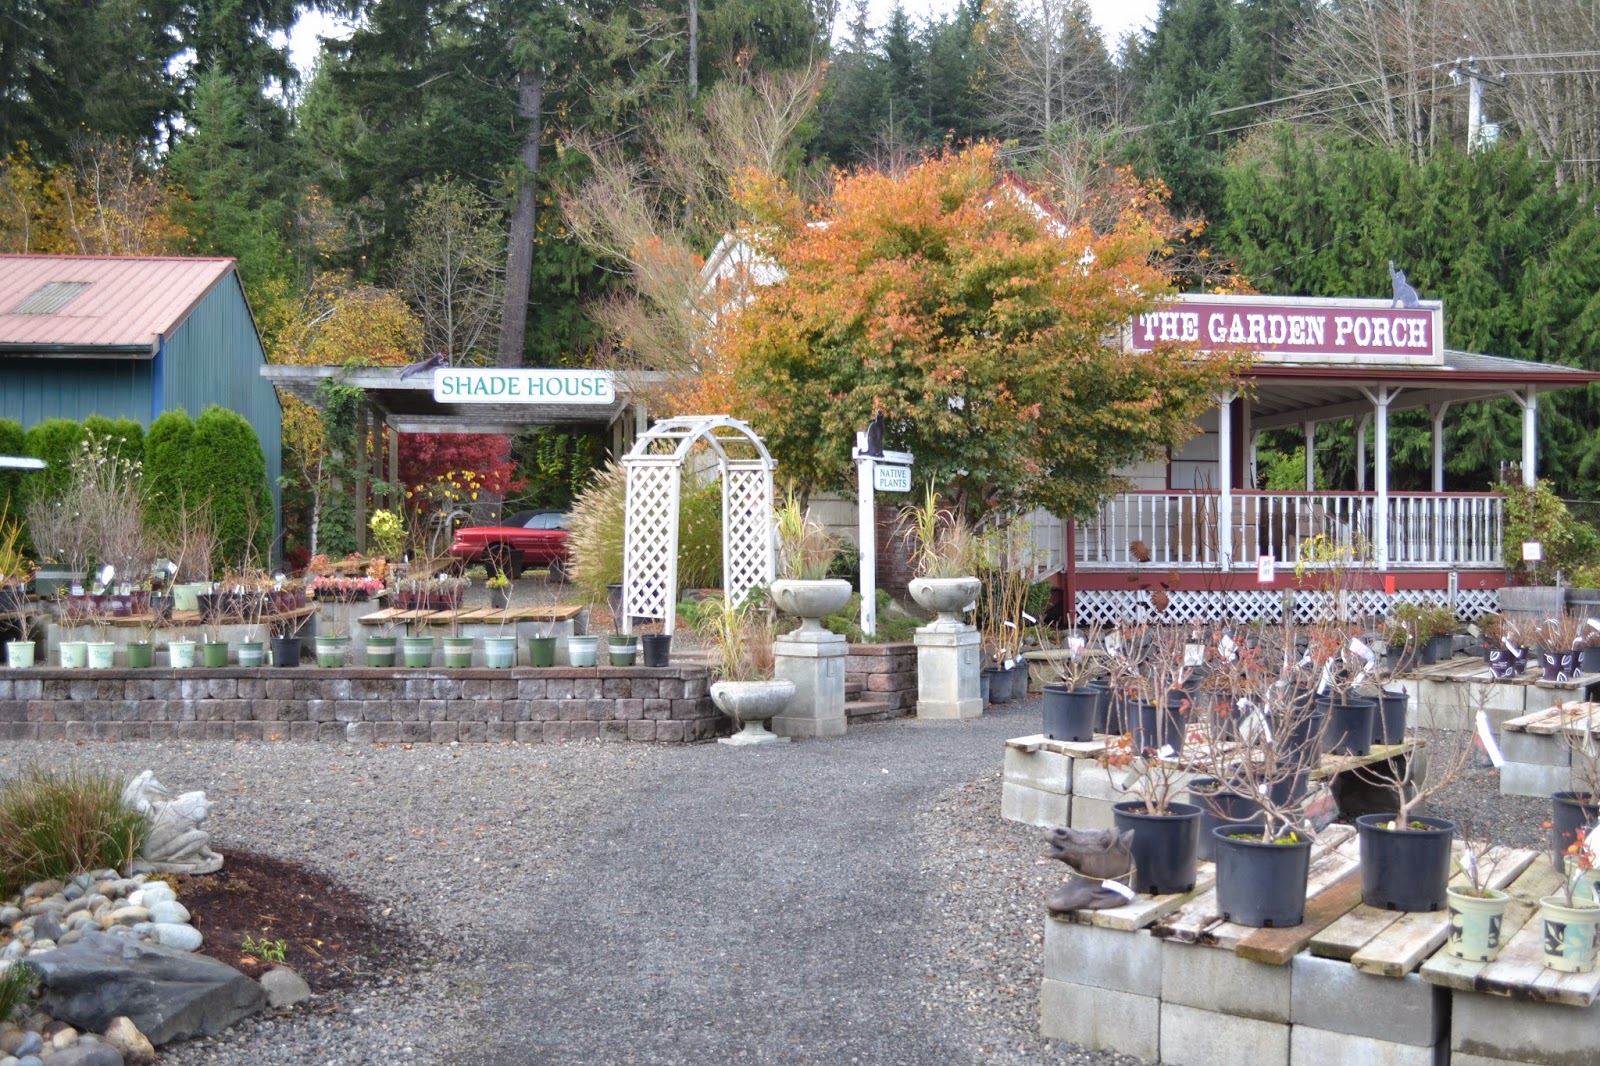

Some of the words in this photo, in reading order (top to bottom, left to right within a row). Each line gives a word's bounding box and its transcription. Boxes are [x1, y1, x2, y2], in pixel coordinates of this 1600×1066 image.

[1139, 311, 1199, 342] THE
[1207, 312, 1326, 345] GARDEN
[1334, 316, 1428, 348] PORCH
[441, 376, 521, 396] SHADE
[527, 376, 608, 396] HOUSE
[880, 469, 907, 478] NATIVE
[880, 478, 907, 488] PLANTS
